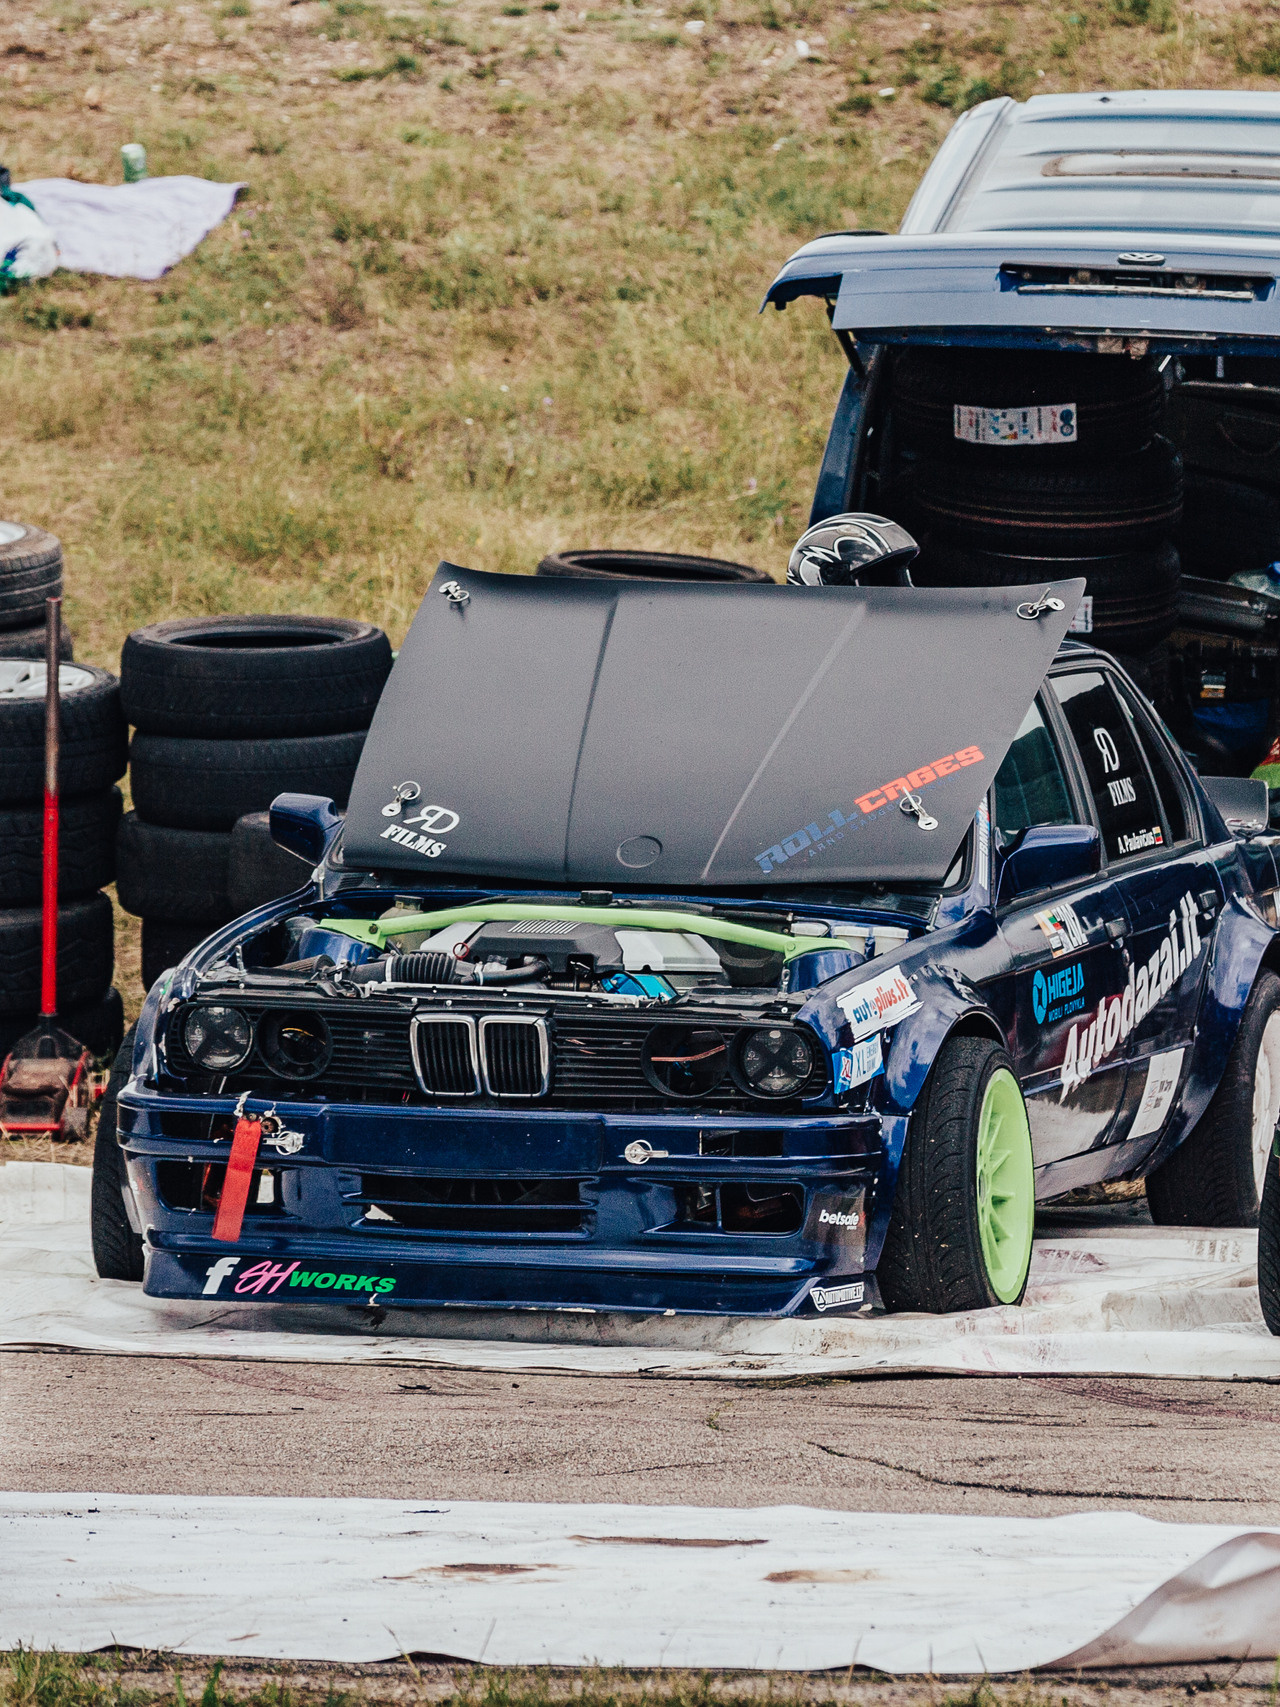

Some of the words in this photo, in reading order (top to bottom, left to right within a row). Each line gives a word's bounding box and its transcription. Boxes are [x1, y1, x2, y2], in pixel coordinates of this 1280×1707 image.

[854, 745, 986, 815] CAGES
[1107, 777, 1137, 807] FILMS
[380, 823, 447, 858] FILMS
[754, 809, 859, 875] ROLL
[1047, 962, 1085, 1005] HIGEJA
[819, 1208, 859, 1226] betsafe
